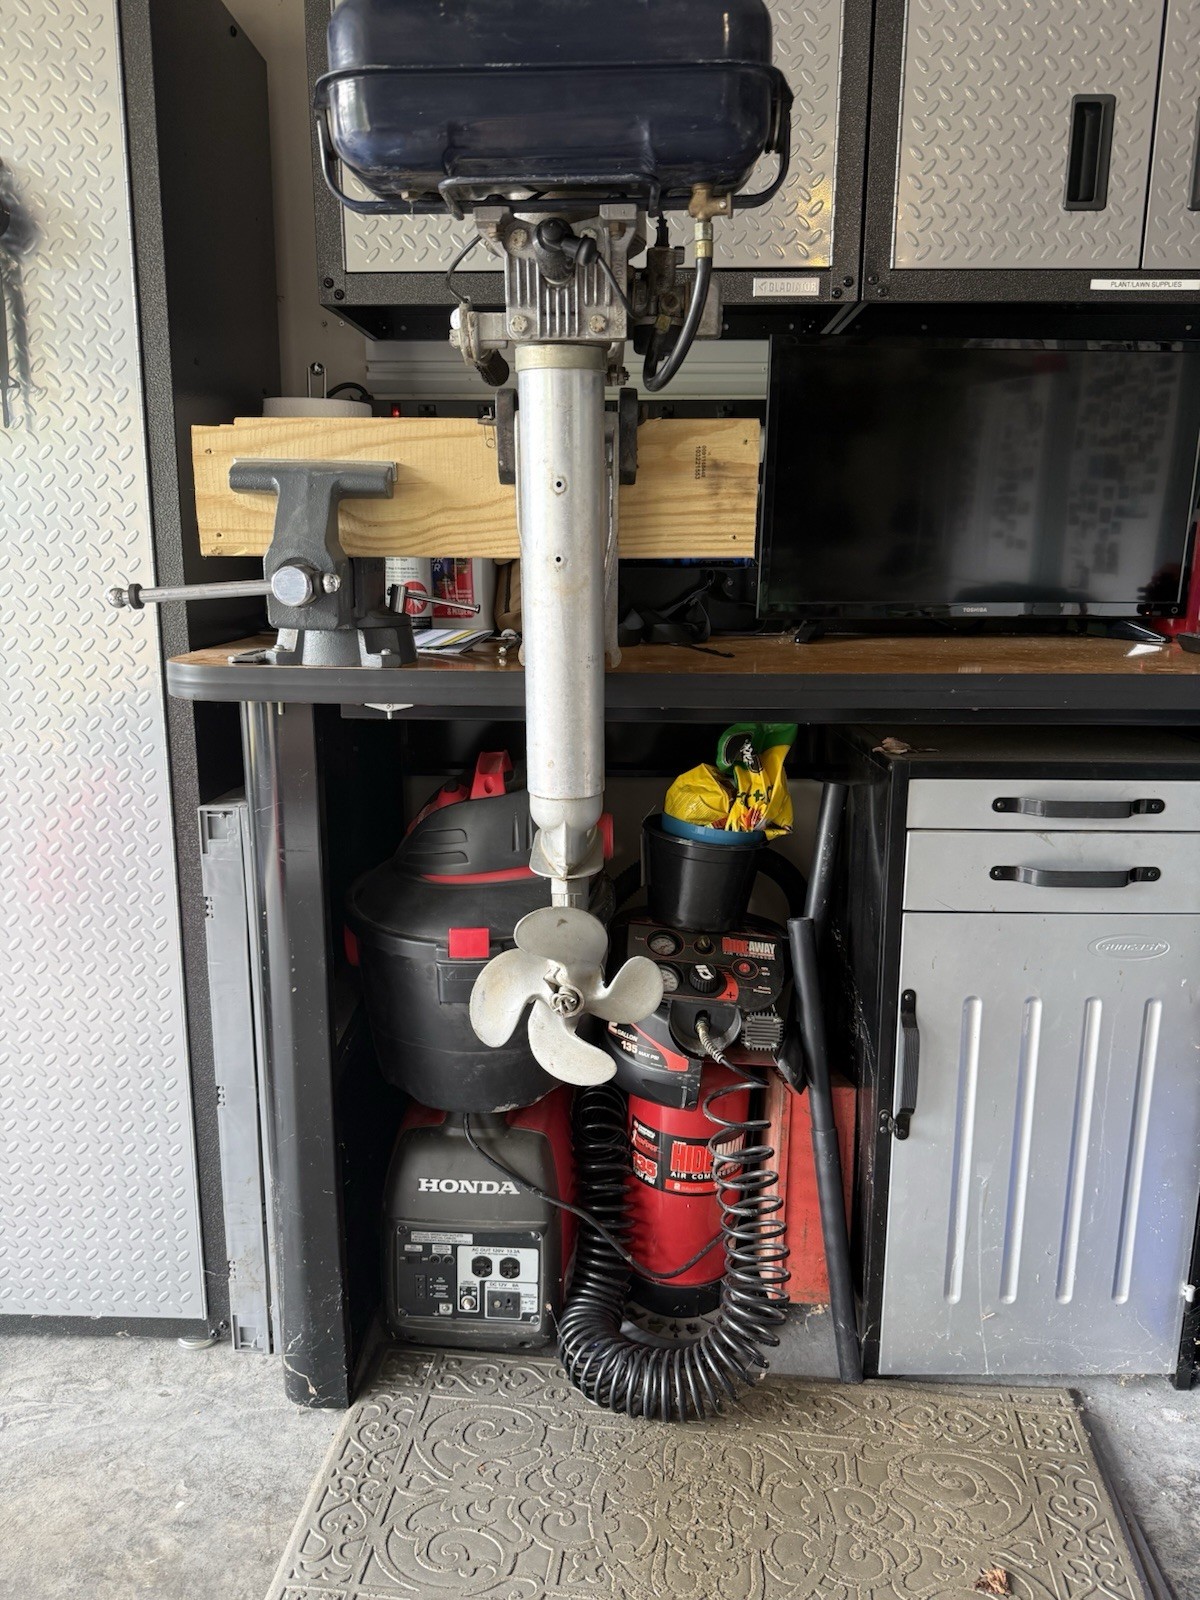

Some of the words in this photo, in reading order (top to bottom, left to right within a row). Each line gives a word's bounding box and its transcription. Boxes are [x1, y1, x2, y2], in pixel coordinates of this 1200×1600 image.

[617, 1029, 638, 1042] GALLON
[620, 1040, 638, 1054] 135
[638, 1050, 650, 1058] MAX
[632, 1150, 658, 1179] 135
[670, 1171, 687, 1180] AIR
[418, 1177, 520, 1195] HONDA
